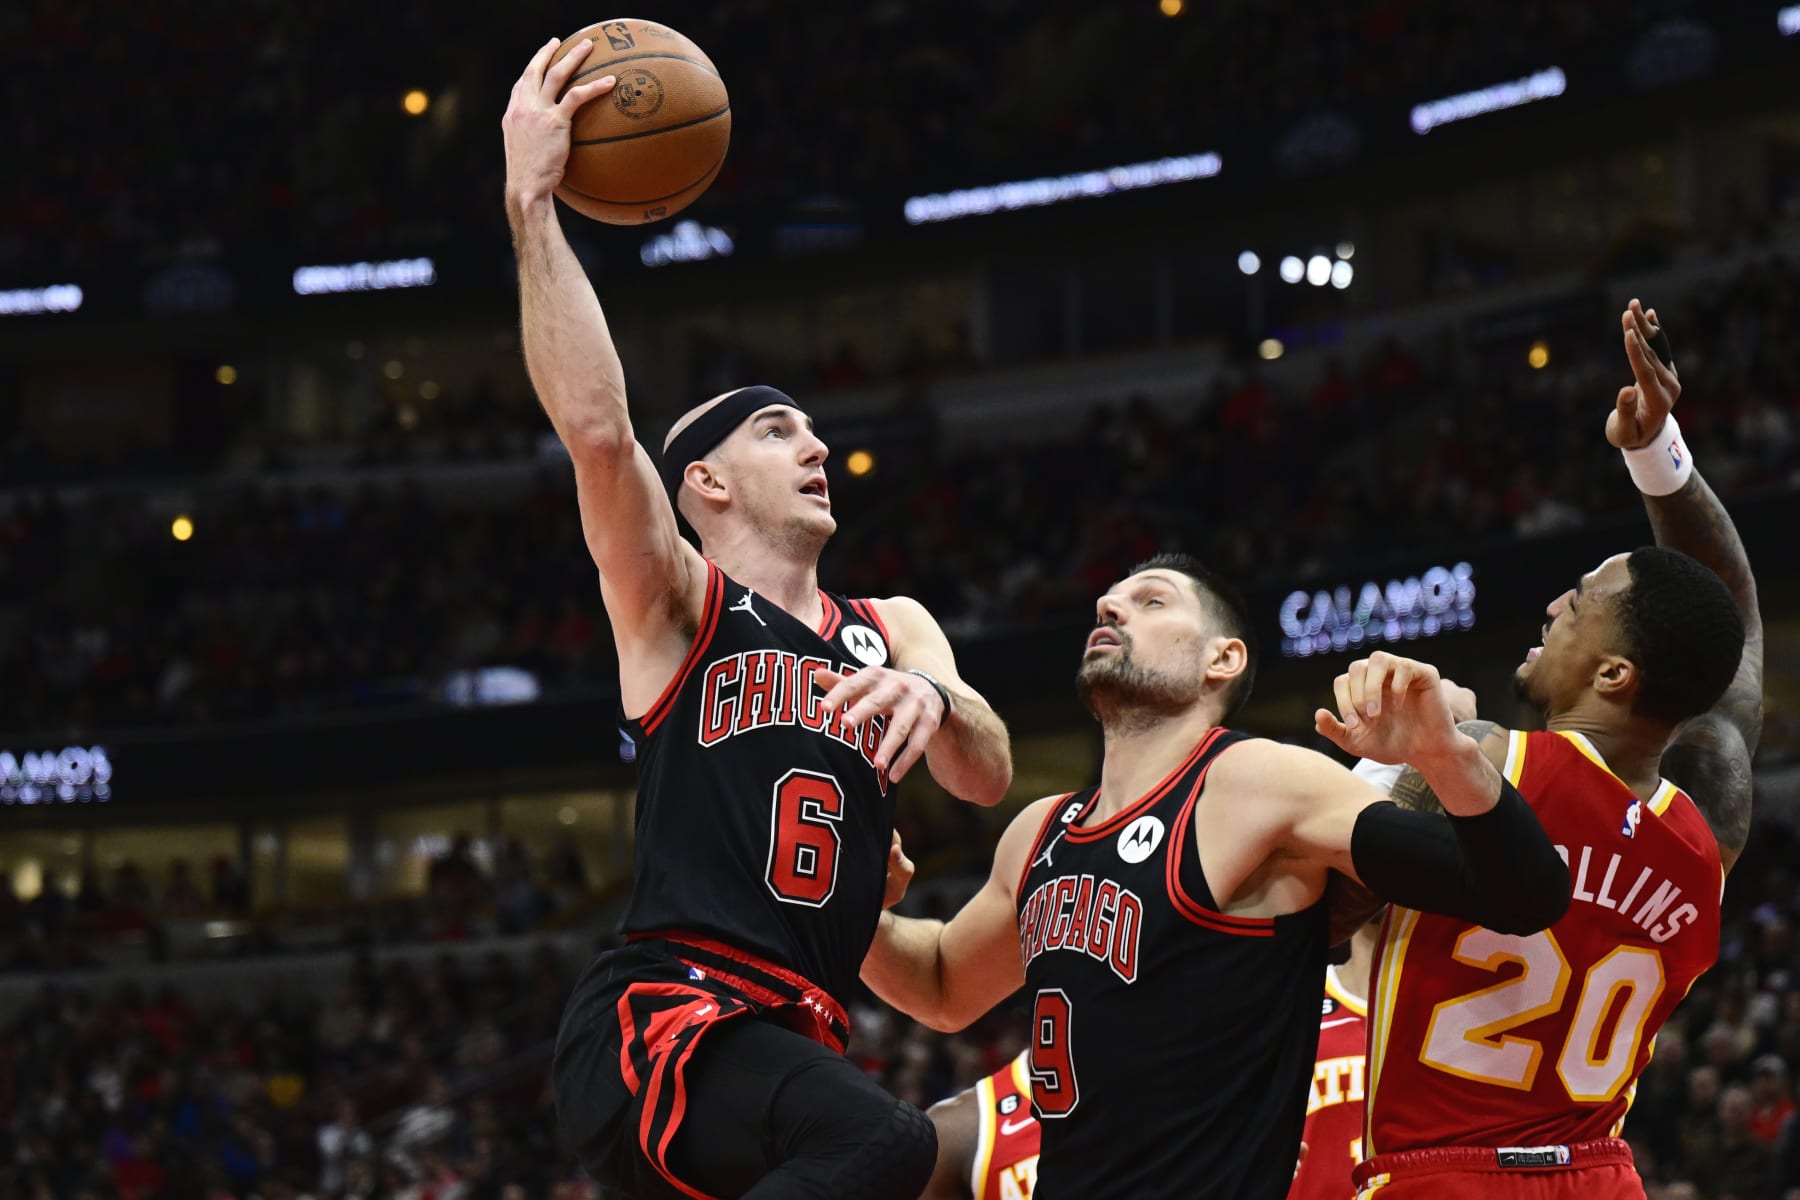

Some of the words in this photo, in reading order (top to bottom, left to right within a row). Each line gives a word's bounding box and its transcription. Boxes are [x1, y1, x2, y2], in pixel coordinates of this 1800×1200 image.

[765, 767, 845, 908] 6
[1061, 802, 1084, 823] 6
[1553, 844, 1699, 943] LLINS
[1029, 988, 1080, 1119] 9
[1418, 925, 1666, 1102] 20
[1000, 1094, 1018, 1115] 6
